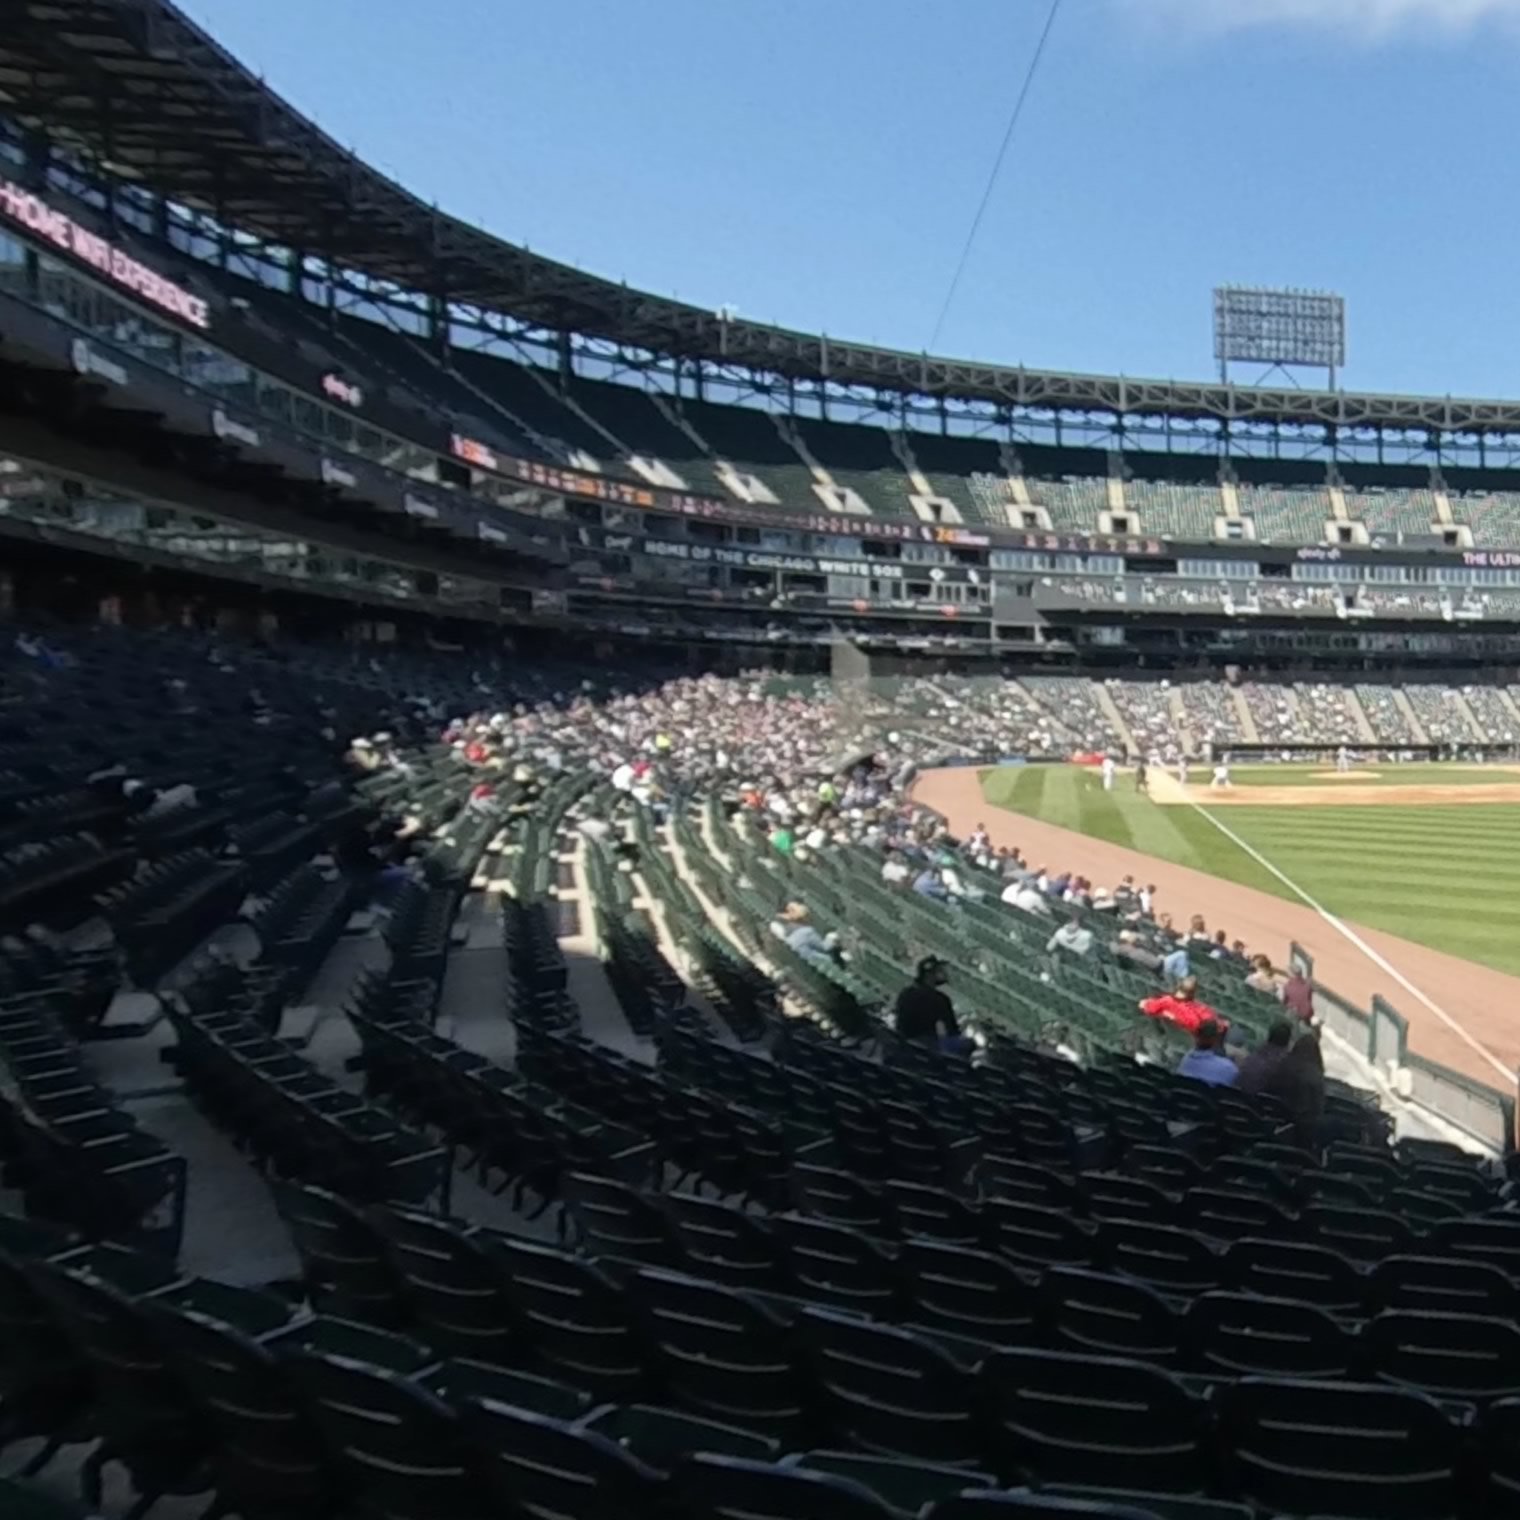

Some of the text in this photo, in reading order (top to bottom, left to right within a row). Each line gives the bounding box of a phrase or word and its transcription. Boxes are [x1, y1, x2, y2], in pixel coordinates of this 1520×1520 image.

[111, 249, 209, 329] EXPERIENCE
[645, 540, 689, 558] HOME
[691, 546, 712, 559] OF
[715, 549, 744, 564] THE
[747, 553, 815, 571] CHICAGO
[818, 560, 869, 575] WHITE
[872, 564, 902, 577] SOX
[1463, 553, 1487, 565] THE
